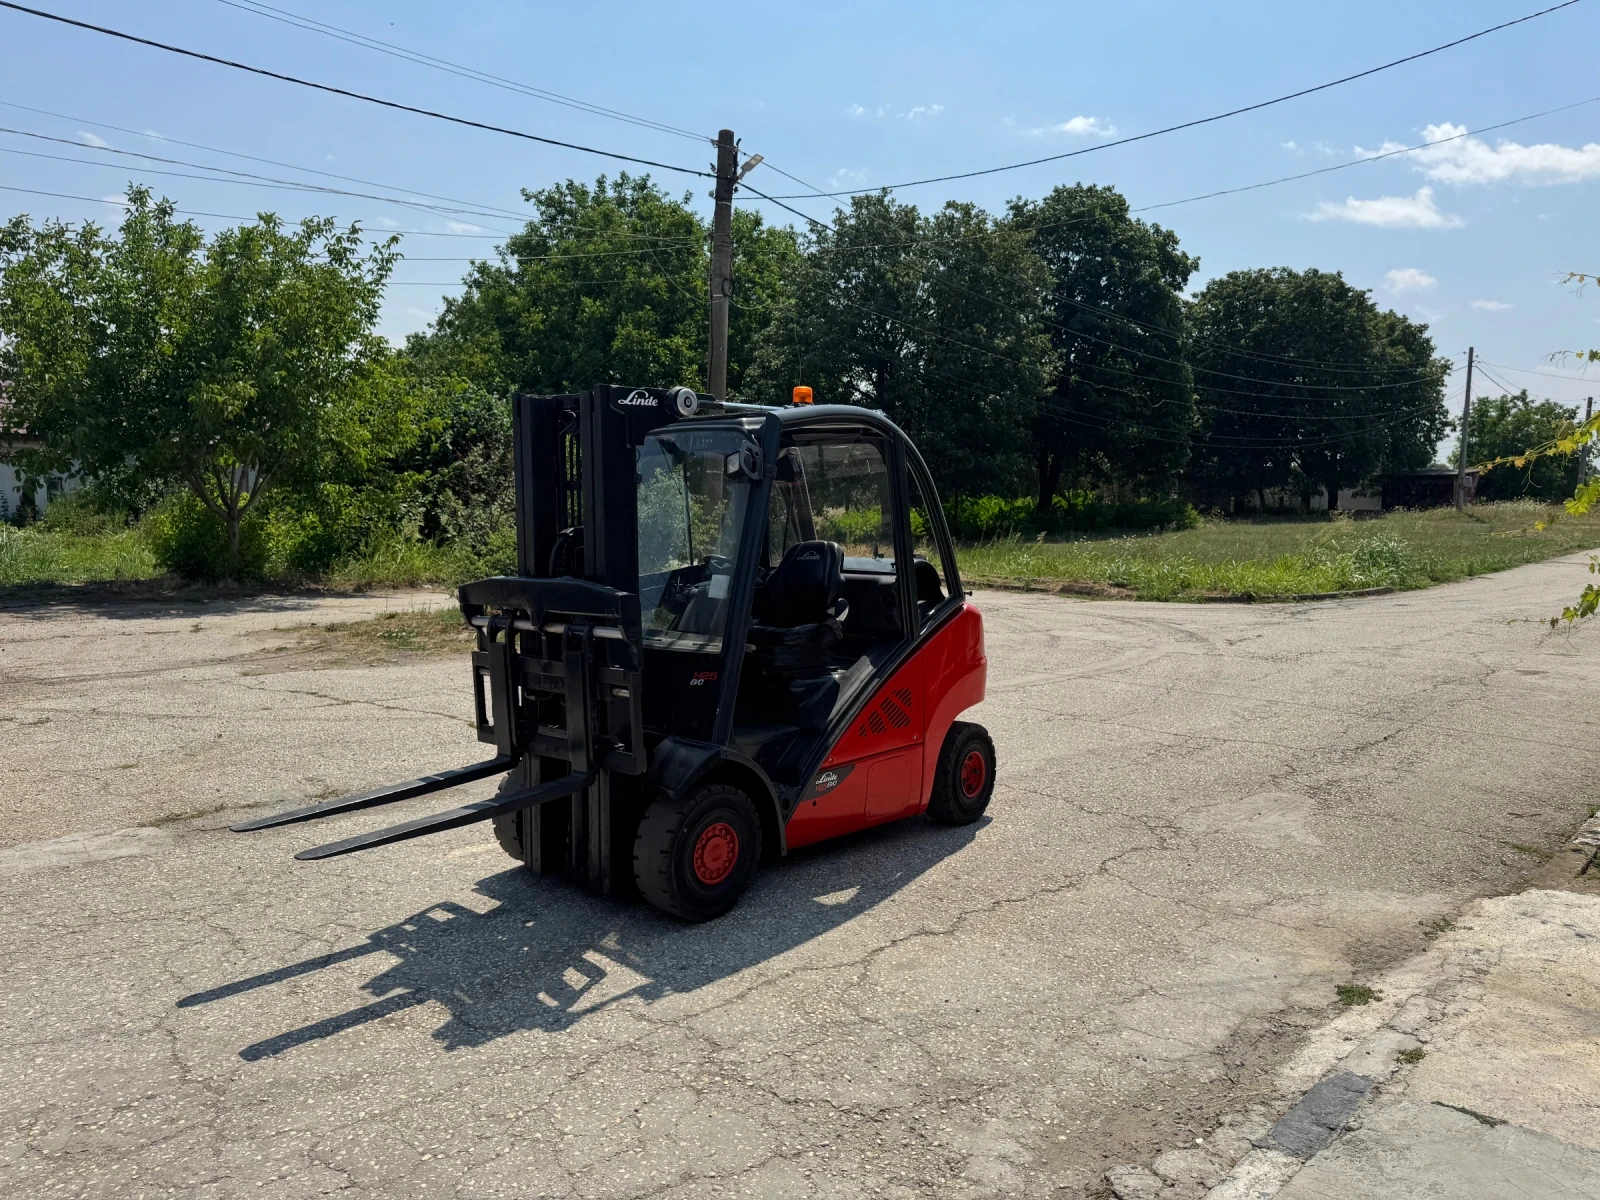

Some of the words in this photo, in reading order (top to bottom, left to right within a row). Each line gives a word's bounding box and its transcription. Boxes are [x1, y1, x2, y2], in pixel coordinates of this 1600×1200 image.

[618, 390, 658, 406] Linde
[797, 551, 820, 560] Linde
[693, 672, 718, 680] H25
[816, 772, 837, 784] Linde
